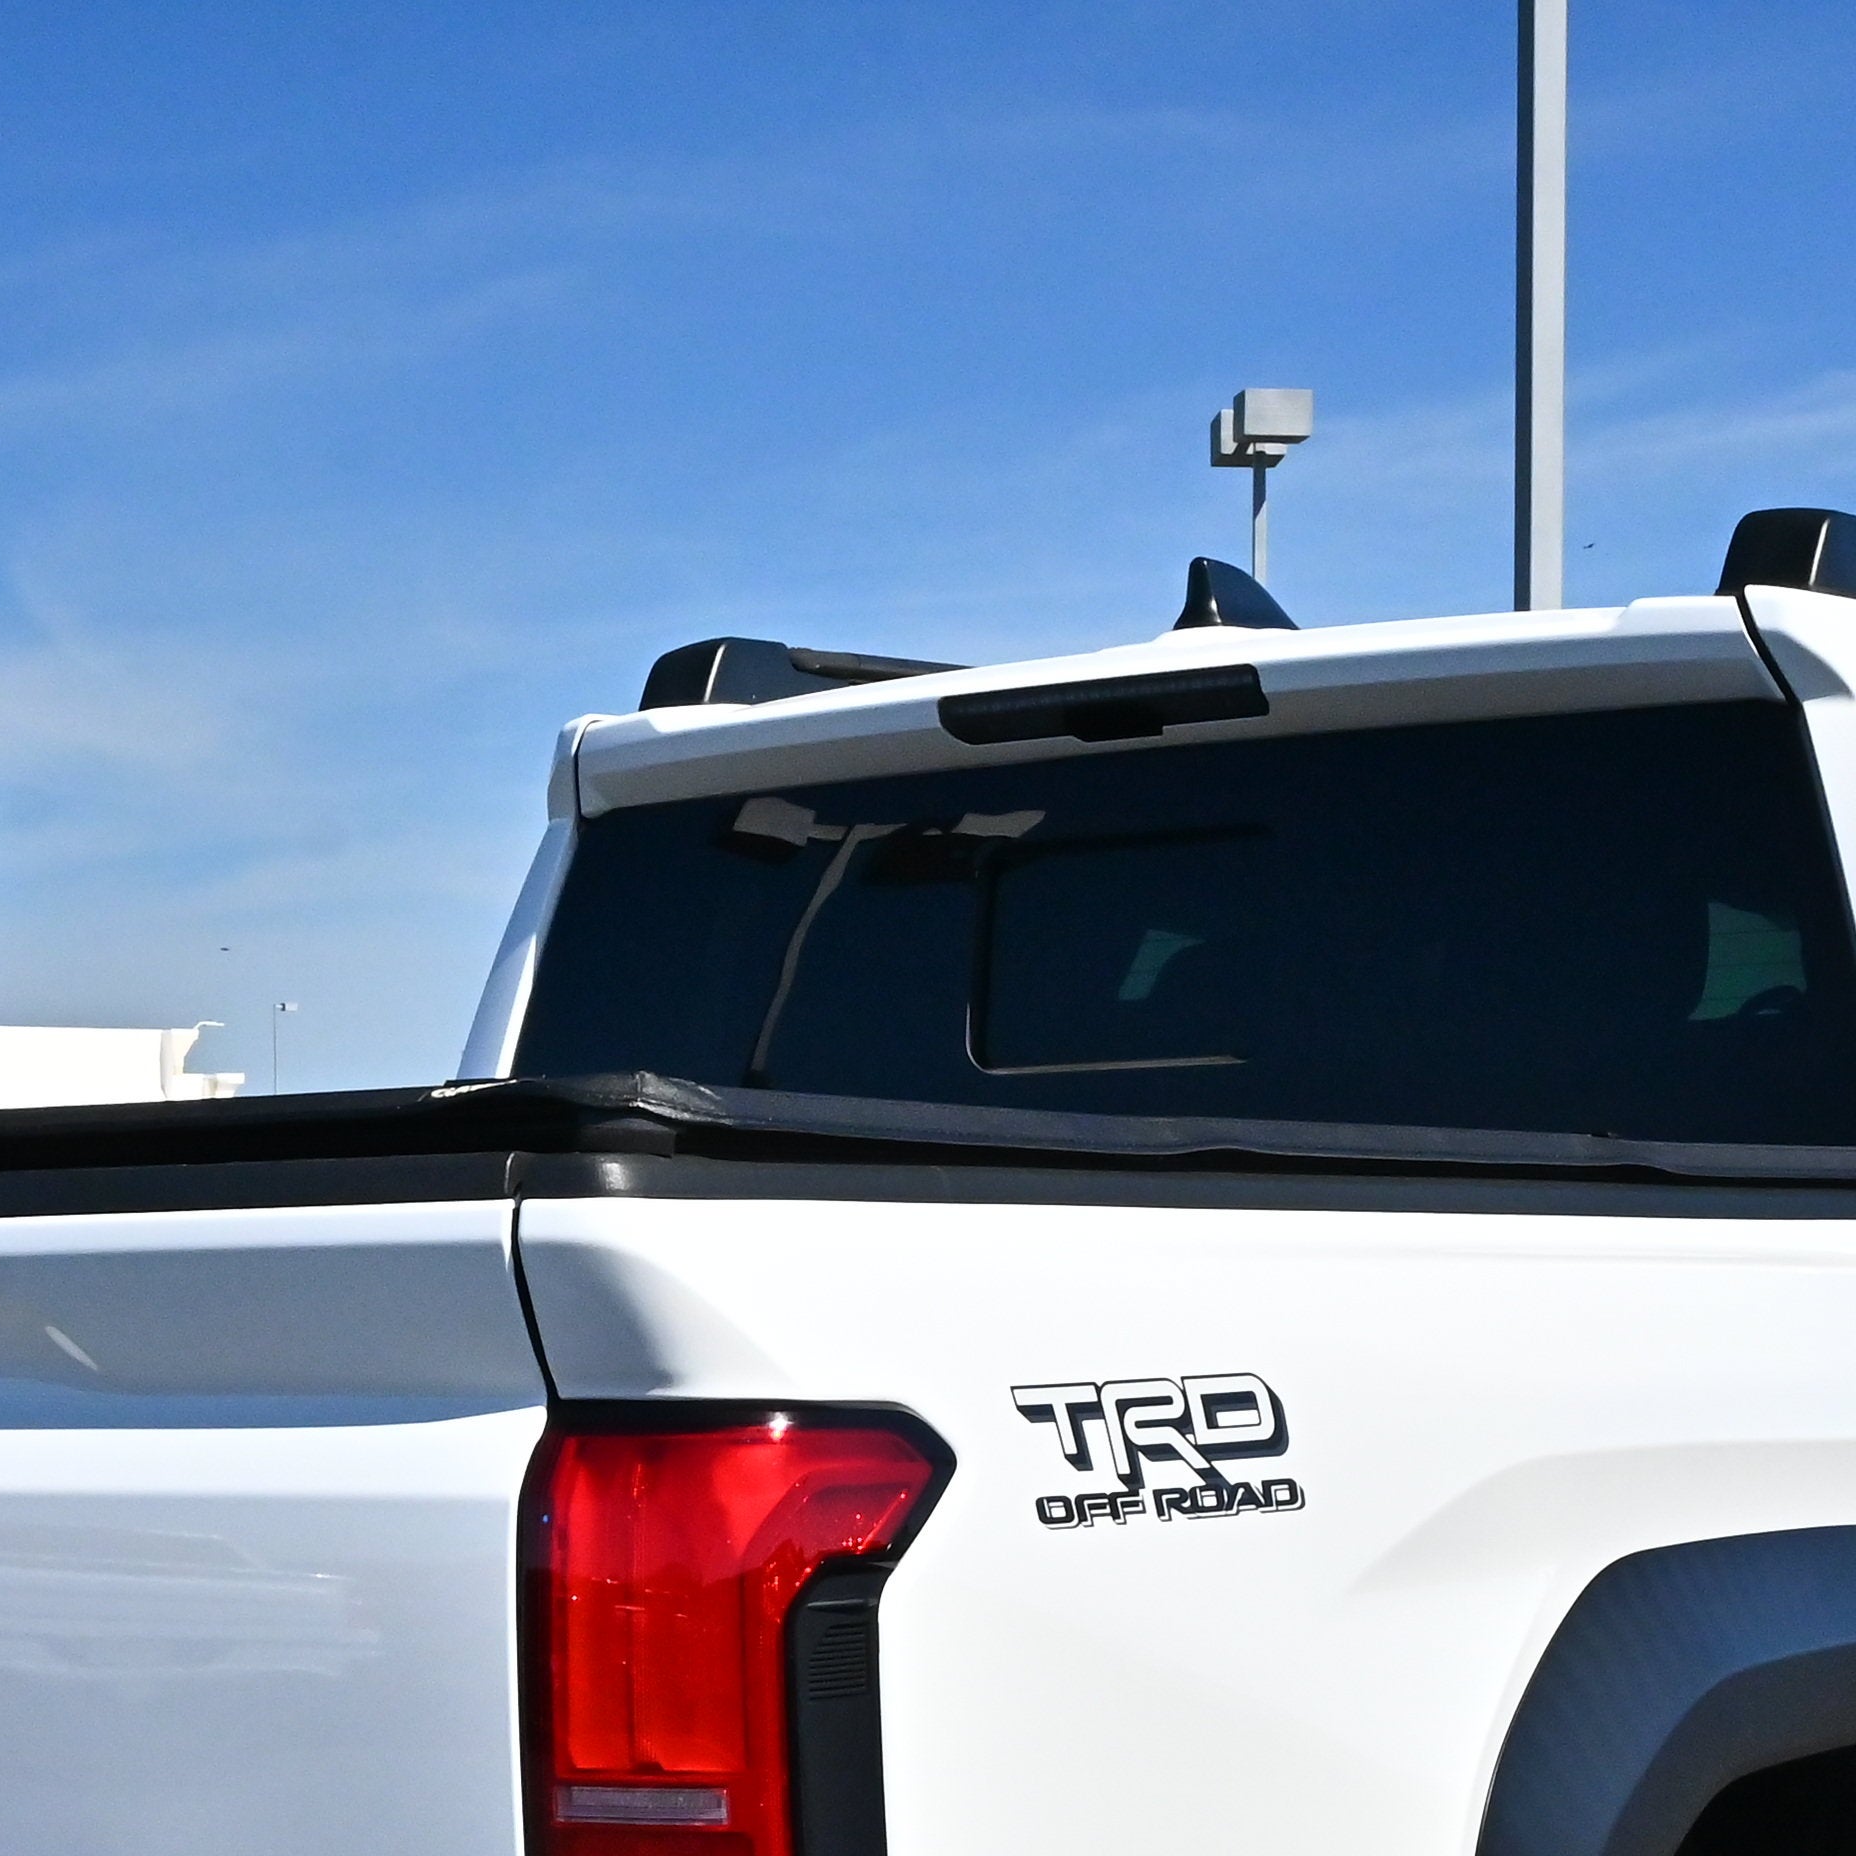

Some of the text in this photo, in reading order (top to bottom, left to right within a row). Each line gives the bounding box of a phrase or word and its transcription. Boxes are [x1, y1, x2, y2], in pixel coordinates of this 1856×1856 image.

[1010, 1373, 1290, 1490] TRD
[1035, 1478, 1306, 1530] OFF ROAD
